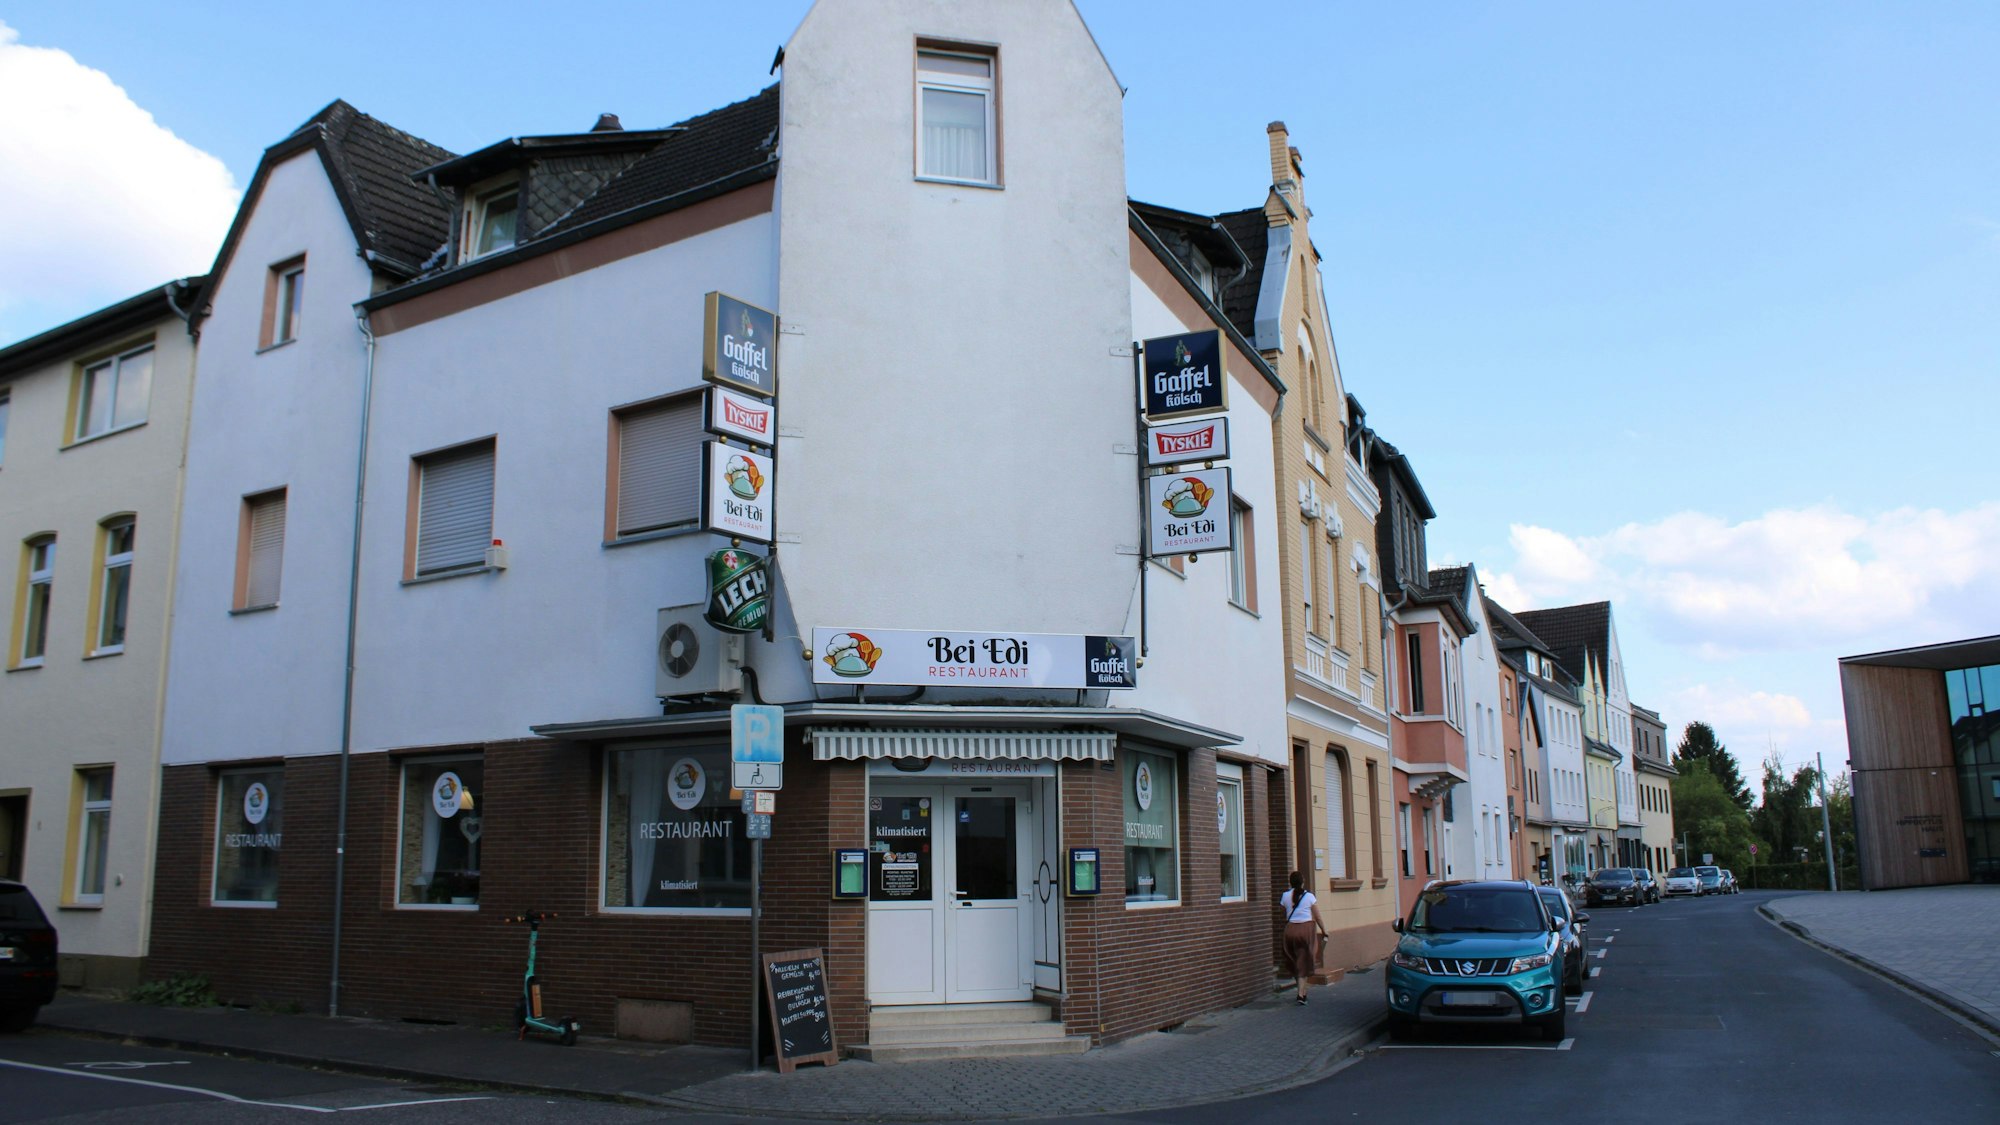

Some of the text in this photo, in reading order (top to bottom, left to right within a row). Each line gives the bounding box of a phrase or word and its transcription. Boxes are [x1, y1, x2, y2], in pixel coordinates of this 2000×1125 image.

[724, 334, 767, 371] Gaffel
[1154, 364, 1213, 394] Gaffel
[728, 404, 765, 430] TYSKIE
[1161, 431, 1211, 453] TYSKIE
[724, 499, 763, 522] Bei Edi
[723, 516, 763, 532] RESTAURANT
[1164, 519, 1215, 537] Bei Edi
[1164, 535, 1215, 547] RESTAURANT
[718, 569, 767, 617] LECH
[927, 636, 1029, 665] Bei Edi
[928, 666, 1029, 679] RESTAURANT
[1090, 657, 1130, 675] Gaffel
[744, 713, 771, 756] P
[951, 763, 1040, 773] RESTAURANT
[640, 821, 732, 839] RESTAURANT
[876, 826, 927, 837] klimatisiert
[1126, 822, 1164, 840] RESTAURANT
[225, 834, 282, 848] RESTAURANT
[660, 880, 698, 890] klimatisiert
